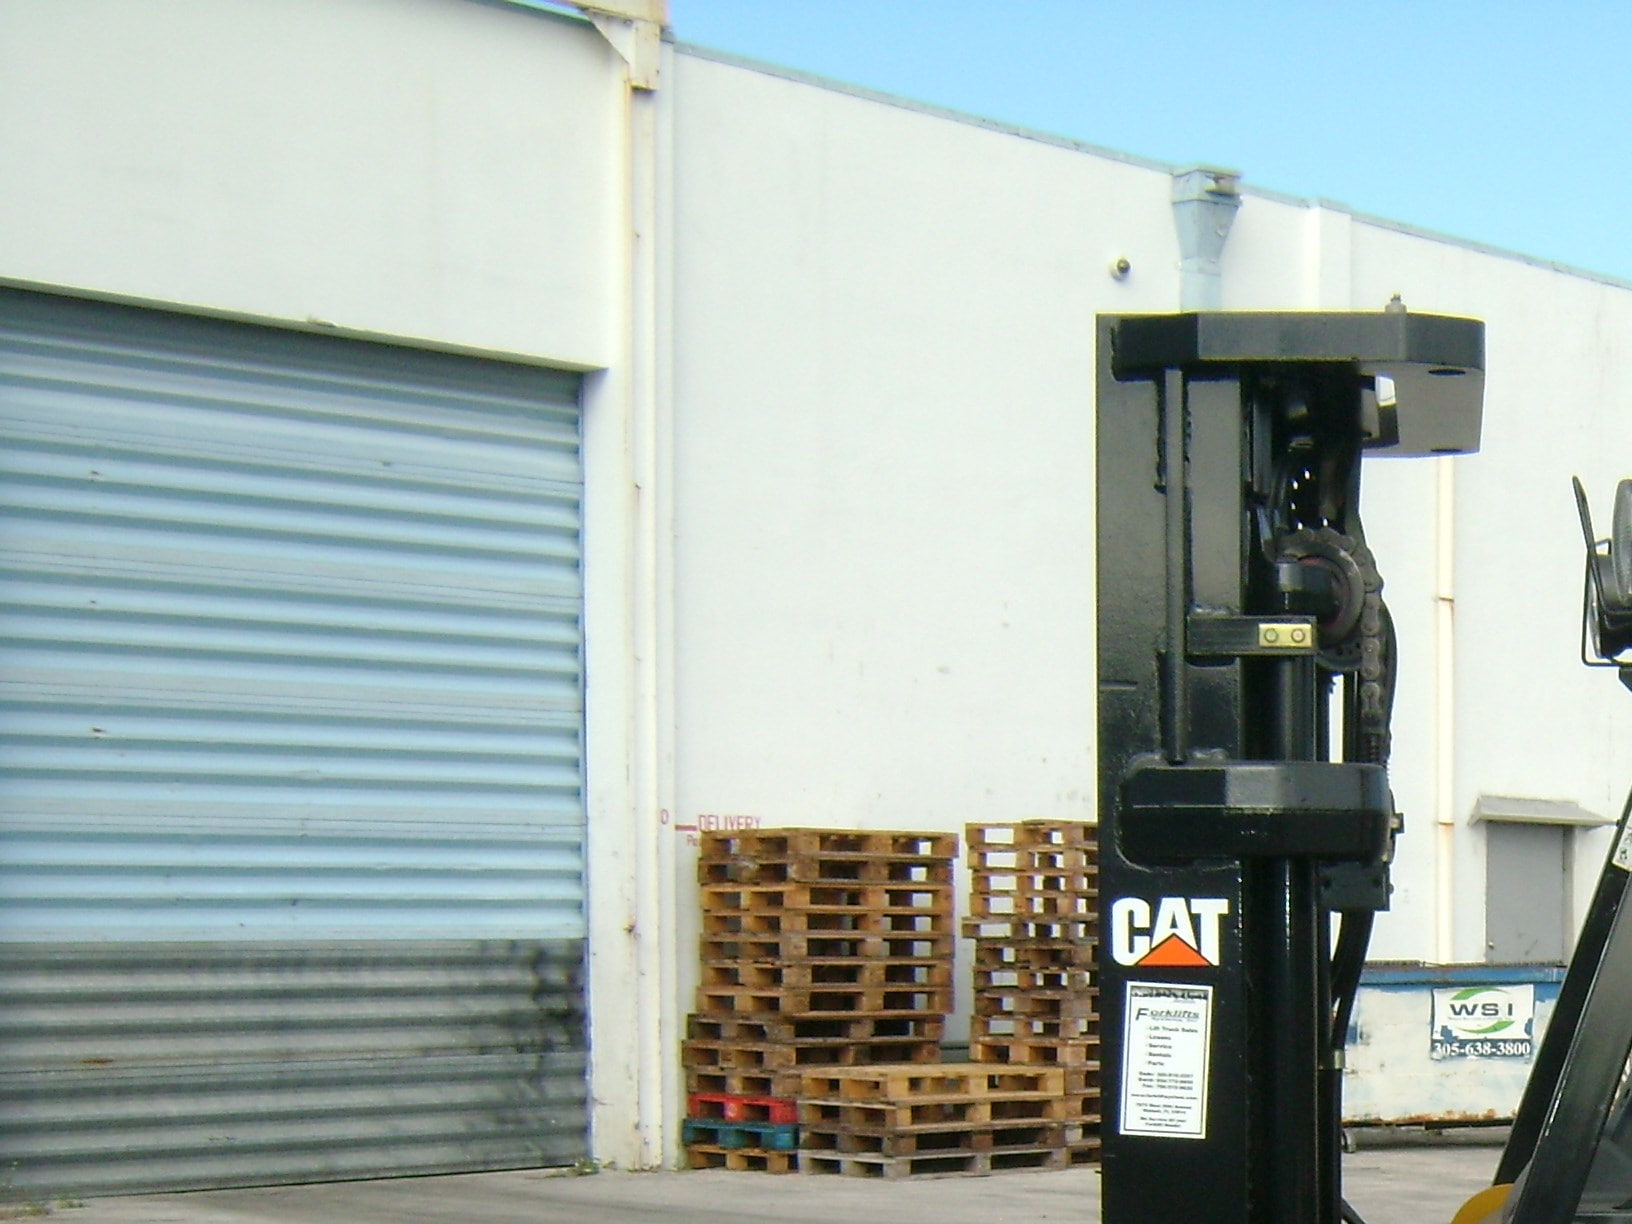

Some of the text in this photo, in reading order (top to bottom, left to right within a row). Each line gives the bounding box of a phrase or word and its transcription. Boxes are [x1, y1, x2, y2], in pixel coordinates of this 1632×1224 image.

[1111, 897, 1229, 966] CAT
[1135, 1008, 1199, 1021] Forklifts
[1449, 1003, 1513, 1016] WSI
[1434, 1041, 1531, 1056] 305-638-3800
